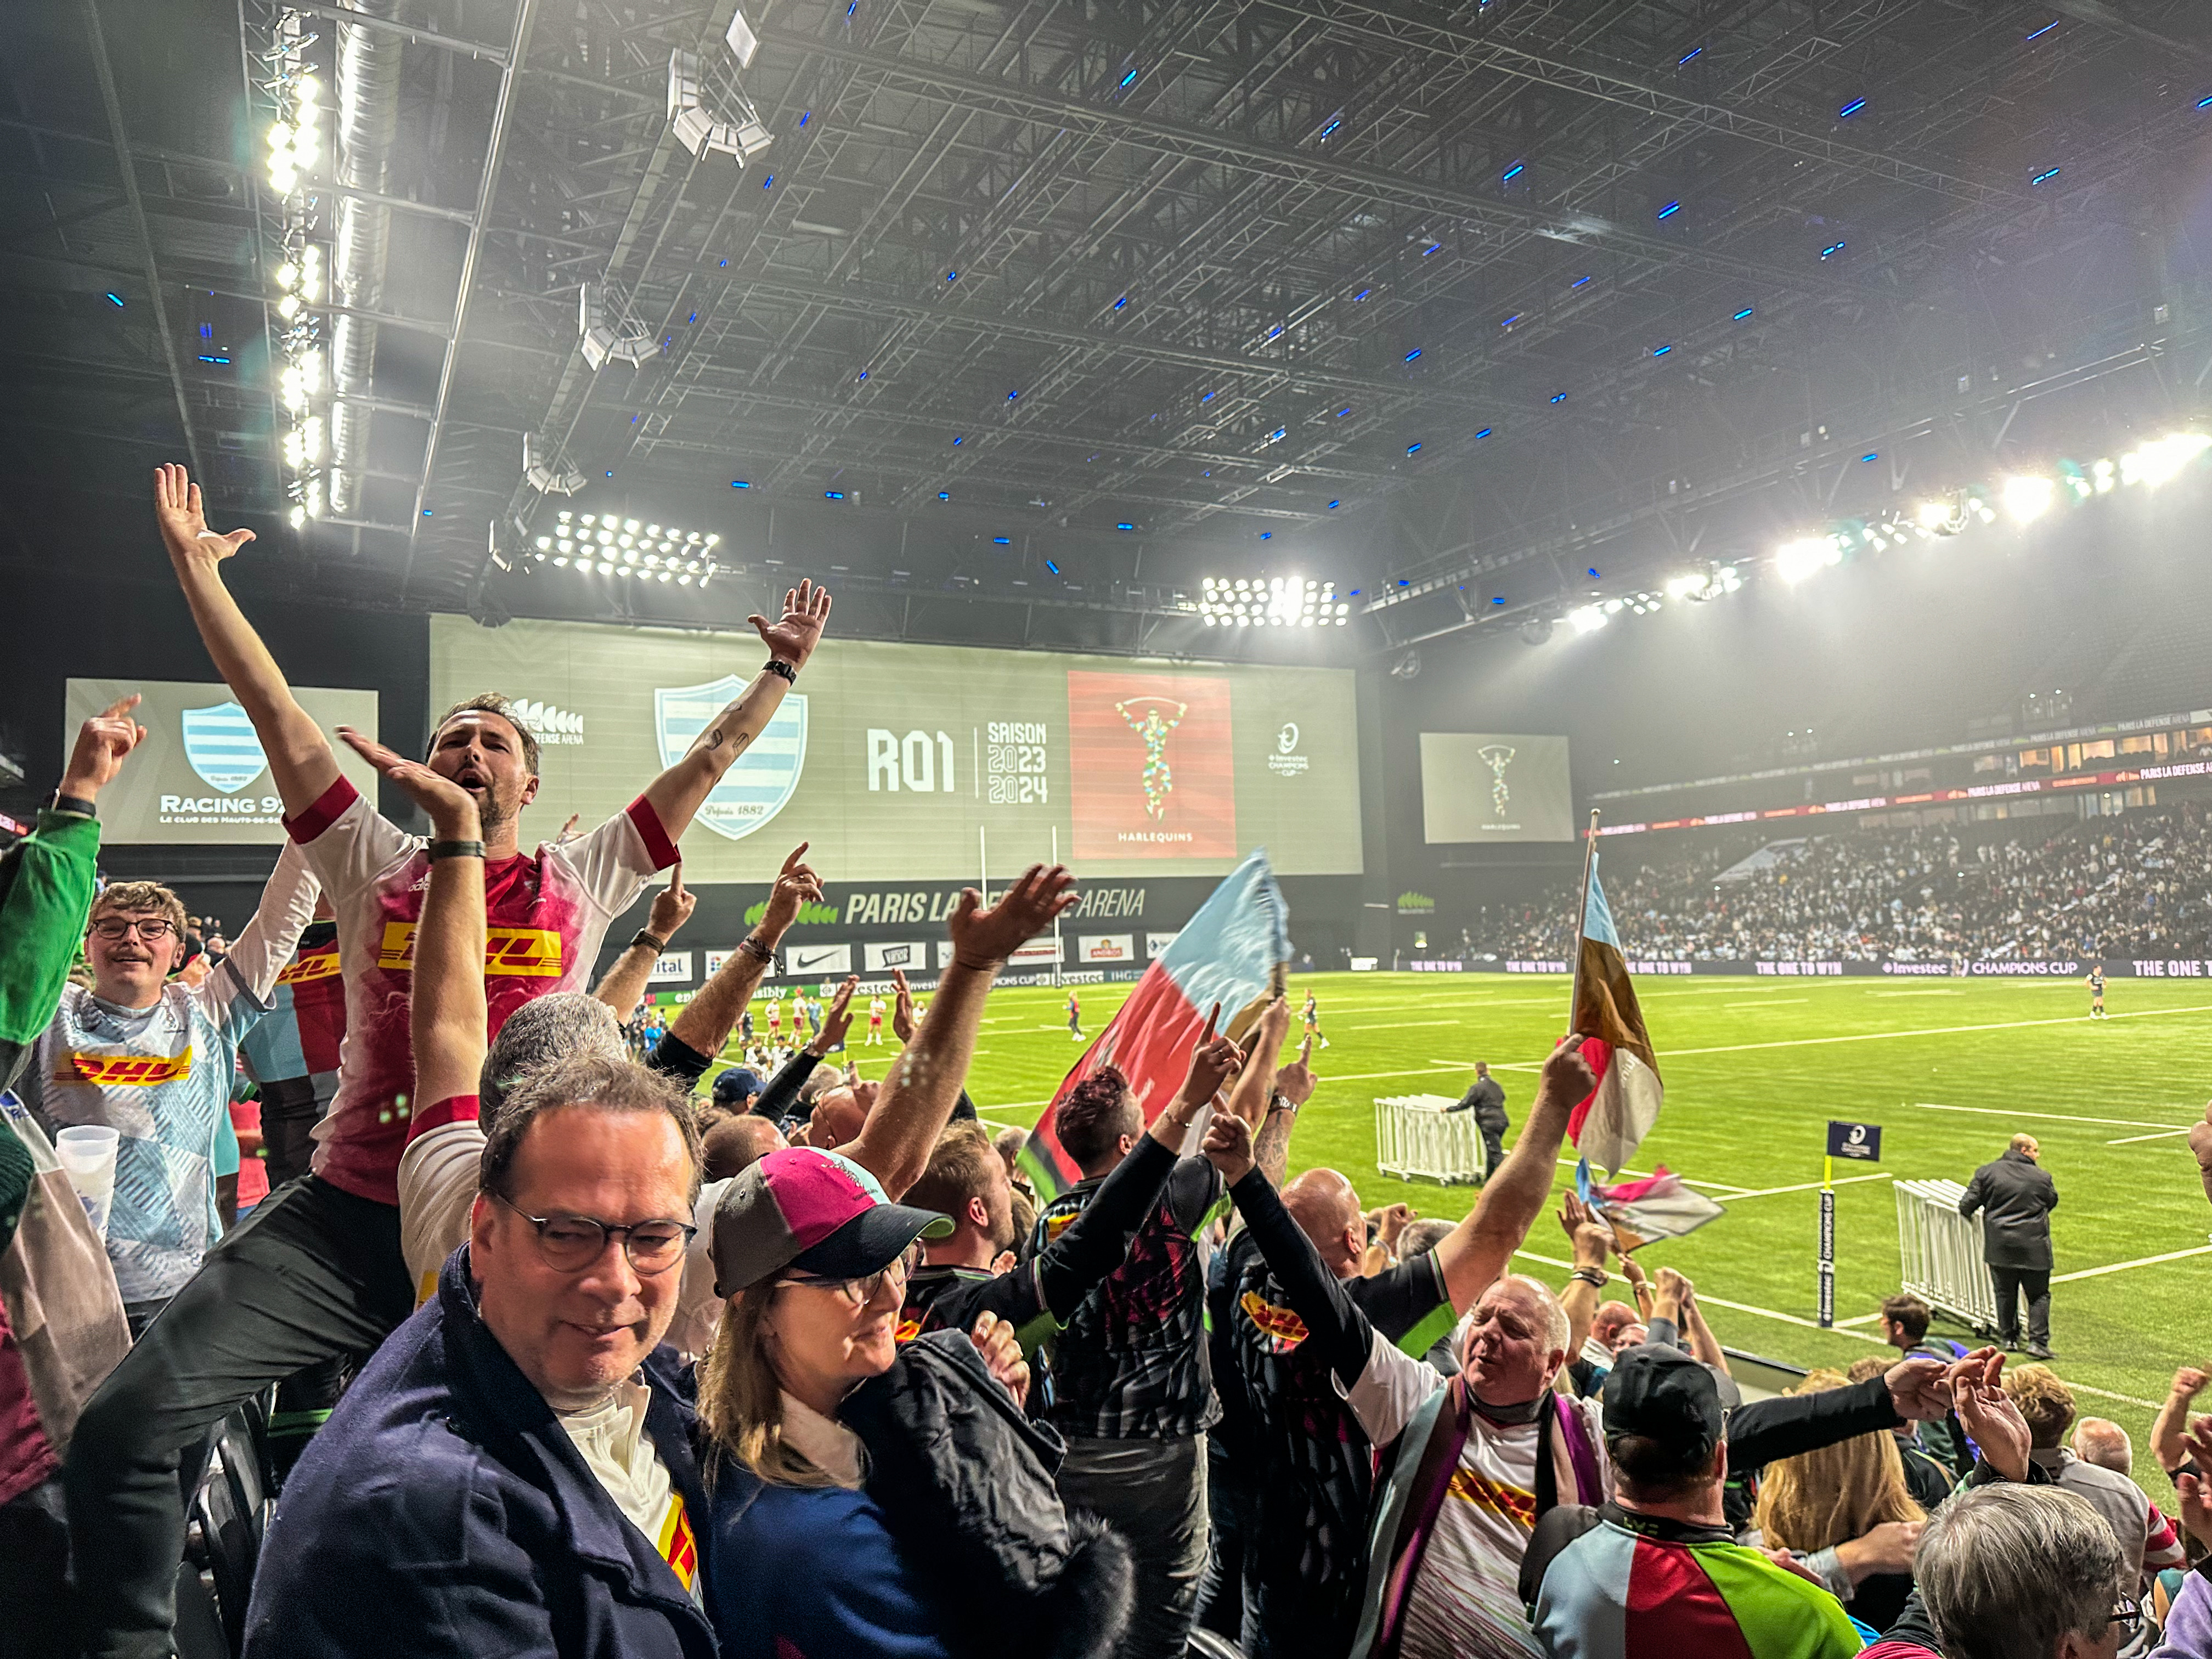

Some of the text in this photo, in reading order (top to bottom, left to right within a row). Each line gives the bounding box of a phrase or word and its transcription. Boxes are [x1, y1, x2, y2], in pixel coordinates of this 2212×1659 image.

[531, 732, 561, 744] FENSE
[988, 721, 1047, 744] SAISON
[988, 744, 1047, 773] 2023
[2140, 768, 2163, 780] PARIS
[2163, 766, 2172, 777] LA
[2172, 763, 2205, 776] DEFENSE
[988, 775, 1048, 804] 2024
[160, 795, 256, 813] RACING
[737, 805, 764, 815] 1882
[1118, 832, 1193, 843] HARLEQUINS
[845, 891, 920, 924] PARIS
[928, 891, 960, 922] LA
[1076, 888, 1146, 917] ARENA
[656, 957, 684, 973] ital
[1972, 961, 2050, 975] CHAMPIONS
[2051, 961, 2079, 974] CUP
[2132, 960, 2212, 977] THE ONE T
[1111, 971, 1132, 981] IHG
[71, 1059, 179, 1082] DHL
